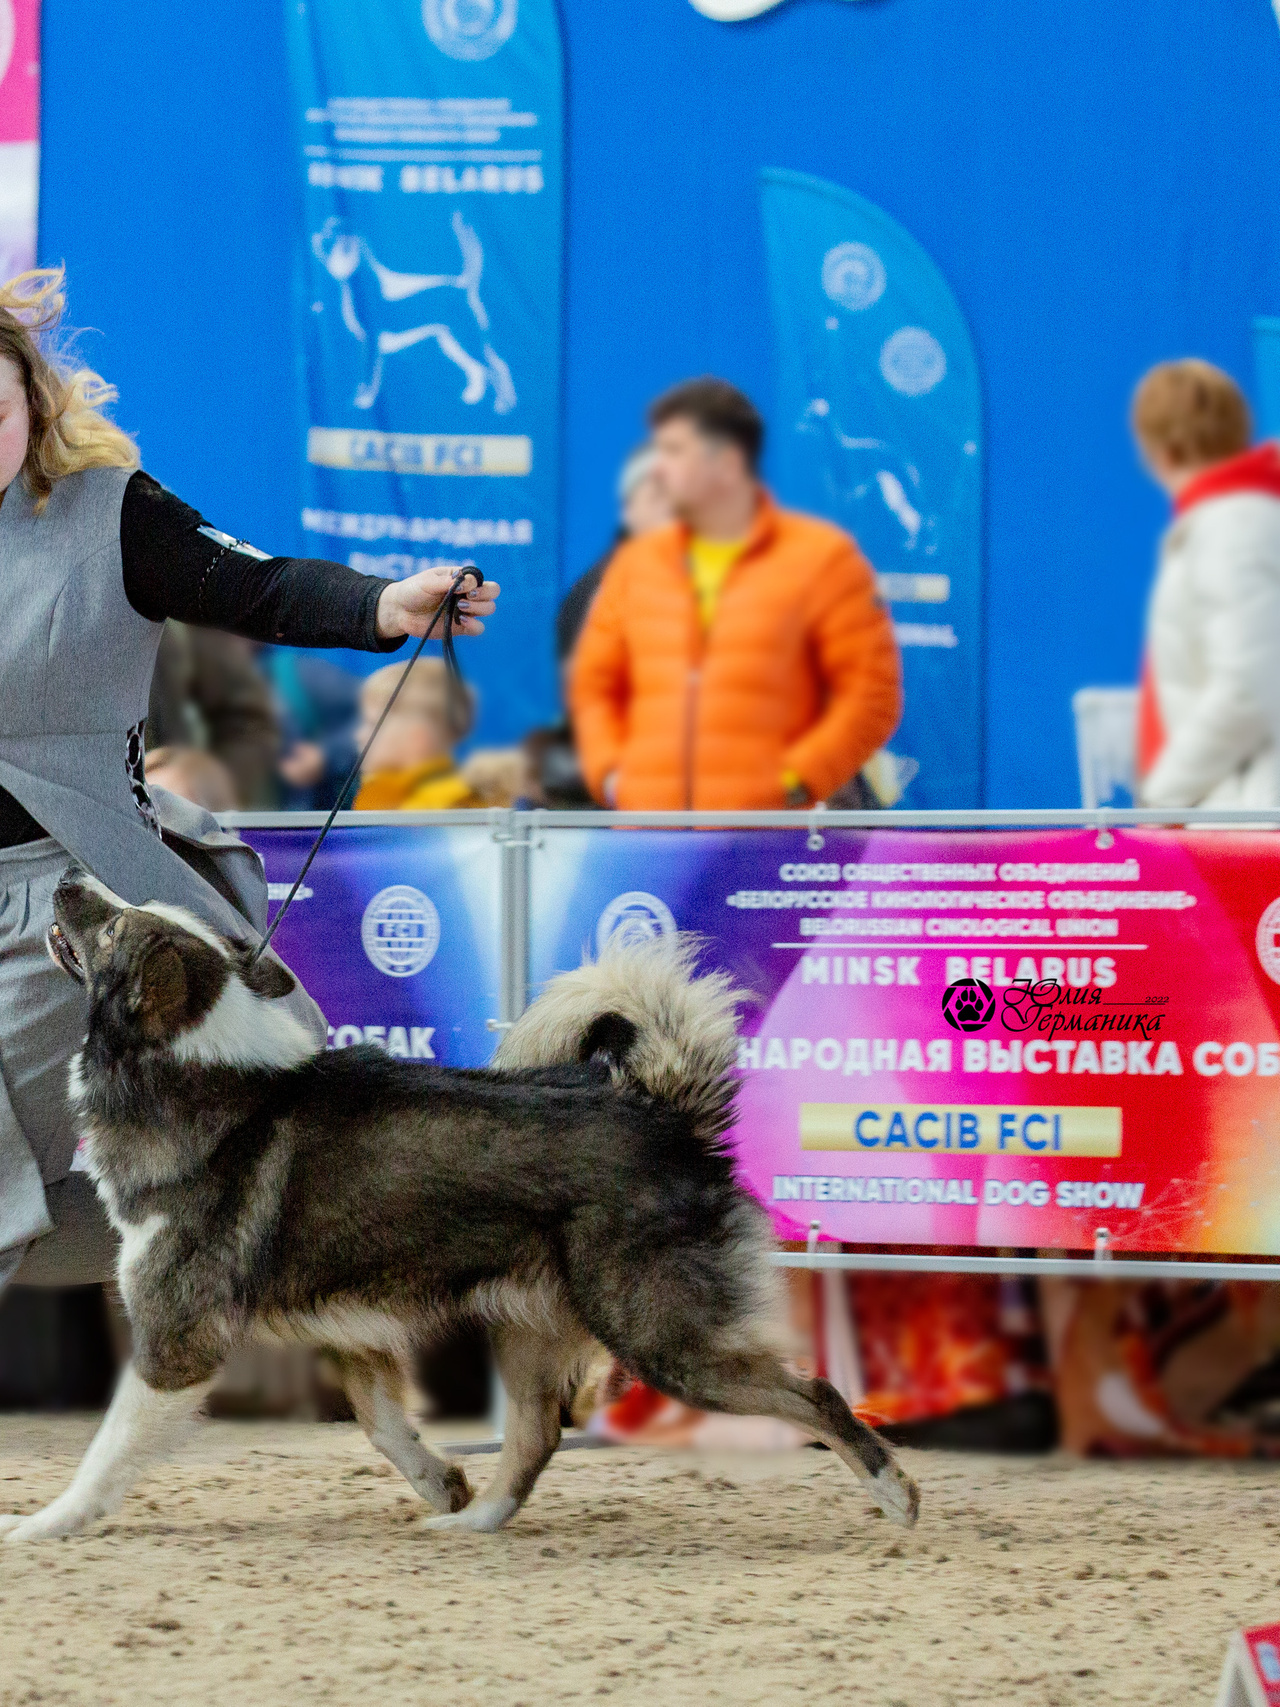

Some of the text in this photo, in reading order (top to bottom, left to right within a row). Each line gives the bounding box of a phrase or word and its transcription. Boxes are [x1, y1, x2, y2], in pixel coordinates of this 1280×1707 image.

[1056, 918, 1119, 937] UNION
[801, 955, 1118, 988] MINSK BELARUS
[736, 1036, 1280, 1077] НАРОДНАЯ ВЫСТАВКА СОБ
[854, 1110, 1062, 1151] CACIB FCI
[773, 1175, 1146, 1209] INTERNATIONAL DOG SHOW
